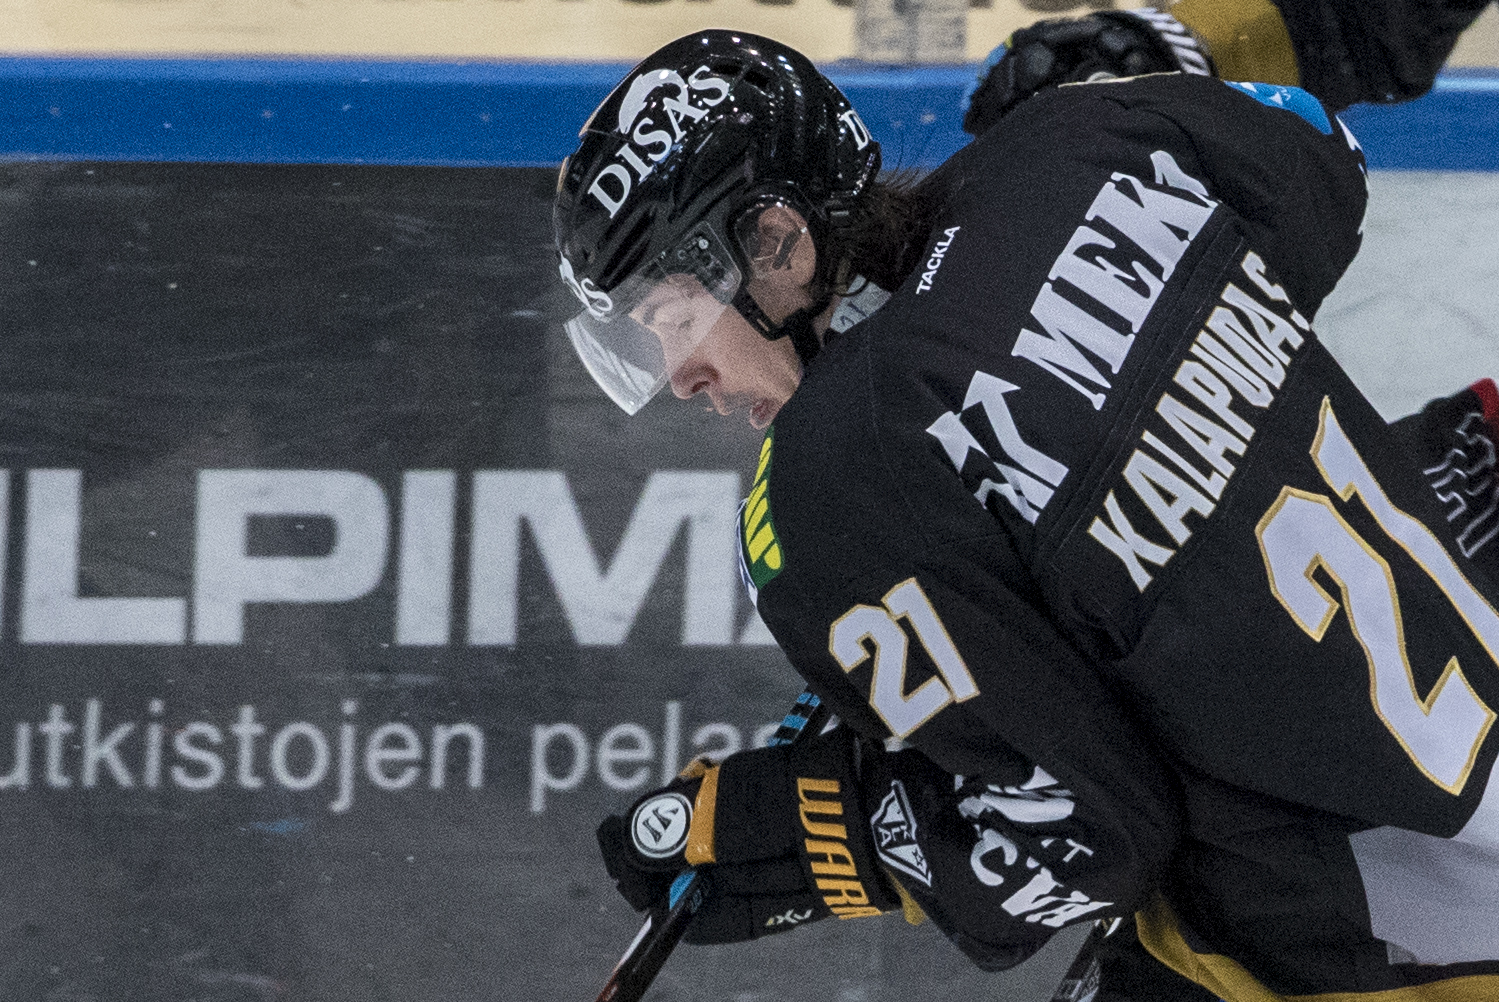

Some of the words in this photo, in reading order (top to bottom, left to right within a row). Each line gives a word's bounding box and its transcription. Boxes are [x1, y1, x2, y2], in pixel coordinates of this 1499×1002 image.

[588, 66, 730, 218] DISAS
[916, 226, 961, 295] TACKLA
[828, 577, 981, 739] 21
